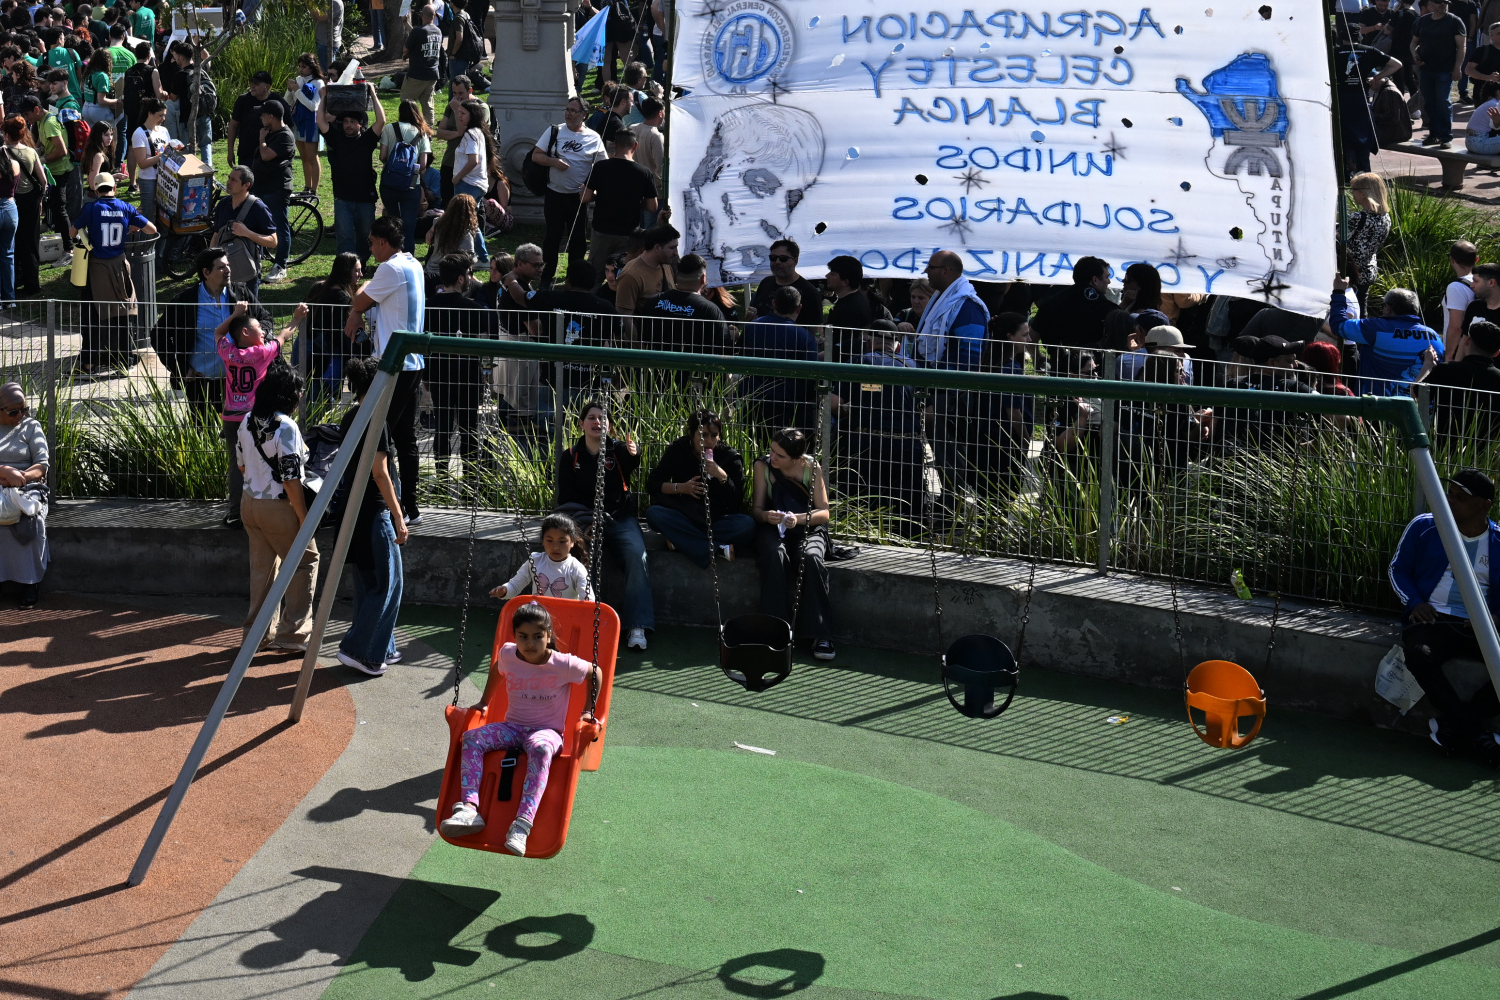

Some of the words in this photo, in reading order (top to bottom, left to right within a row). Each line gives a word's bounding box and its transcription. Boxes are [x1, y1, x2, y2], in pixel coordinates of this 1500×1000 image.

[100, 222, 123, 247] 10
[1392, 328, 1439, 341] APUTN
[233, 395, 248, 403] IZAN
